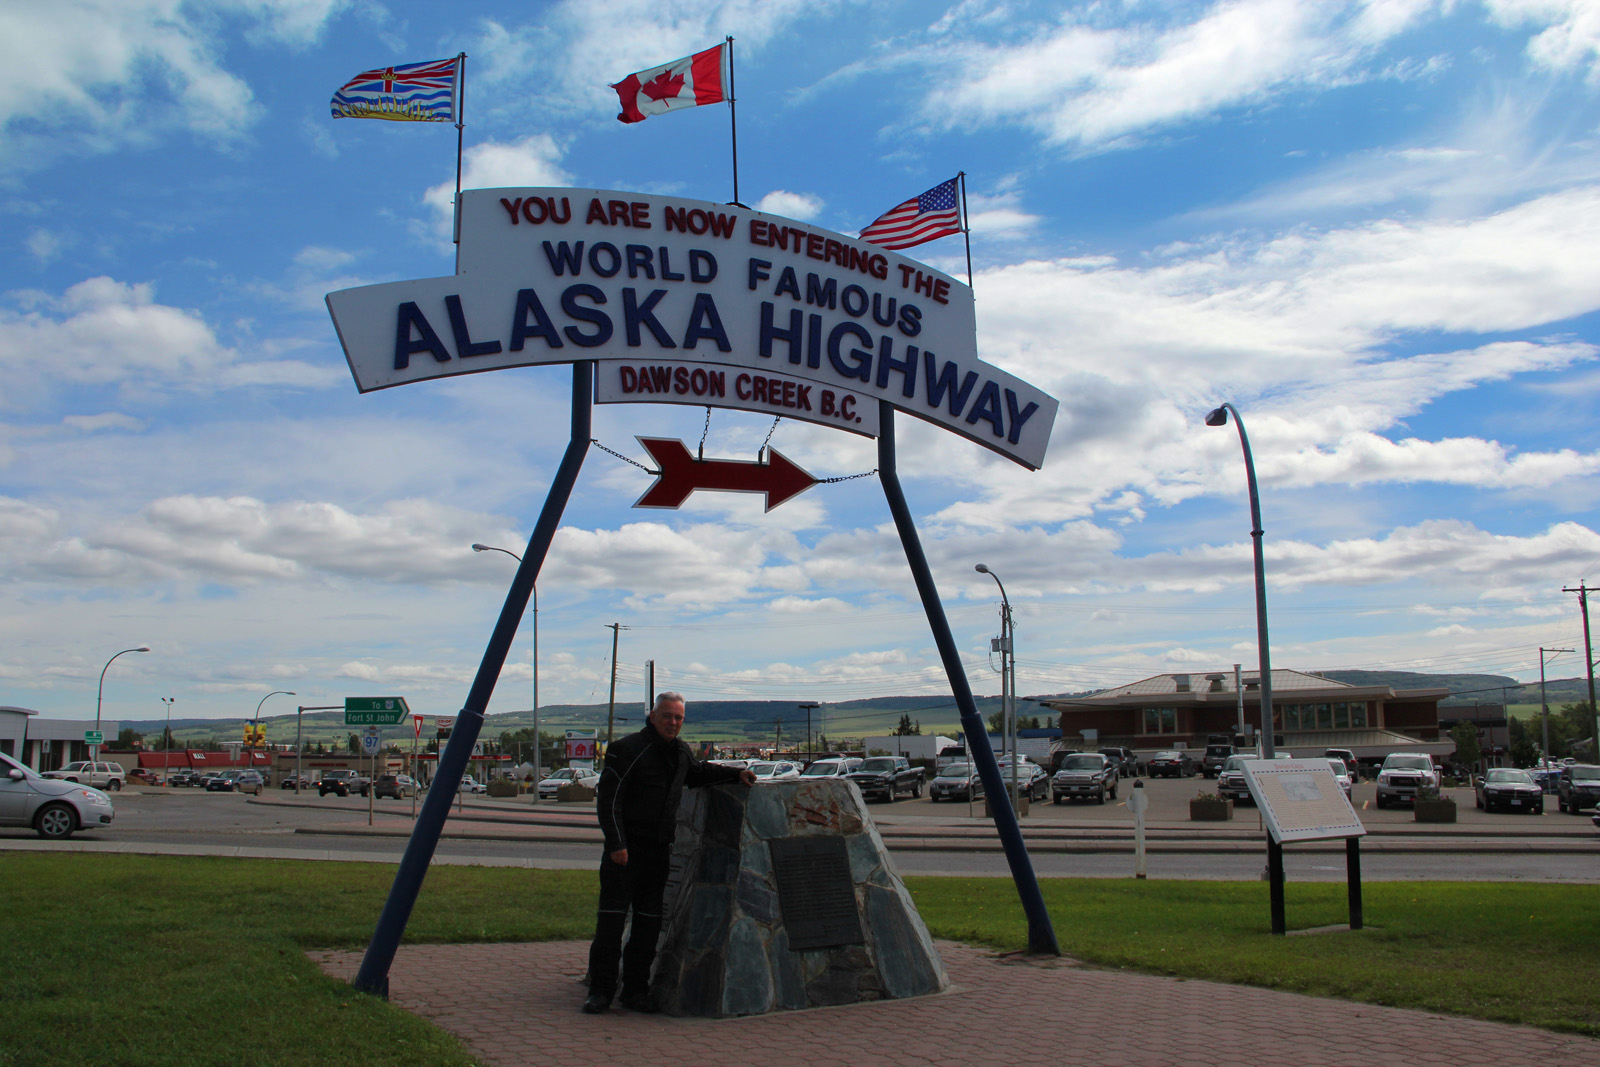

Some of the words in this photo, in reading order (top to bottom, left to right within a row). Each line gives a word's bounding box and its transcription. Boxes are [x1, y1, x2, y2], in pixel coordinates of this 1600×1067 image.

[500, 196, 572, 225] YOU
[586, 198, 652, 229] ARE
[665, 205, 738, 240] NOW
[750, 219, 889, 280] ENTERING
[898, 263, 951, 305] THE
[542, 240, 718, 284] WORLD
[749, 257, 923, 338] FAMOUS
[394, 283, 733, 370] ALASKA
[759, 301, 1040, 445] HIGHWAY
[620, 366, 726, 398] DAWSON
[735, 373, 812, 411] CREEK
[821, 389, 862, 424] B.C.
[348, 714, 364, 722] Fort
[366, 714, 374, 722] St
[376, 714, 395, 722] John
[372, 701, 381, 709] To
[365, 736, 379, 748] 97
